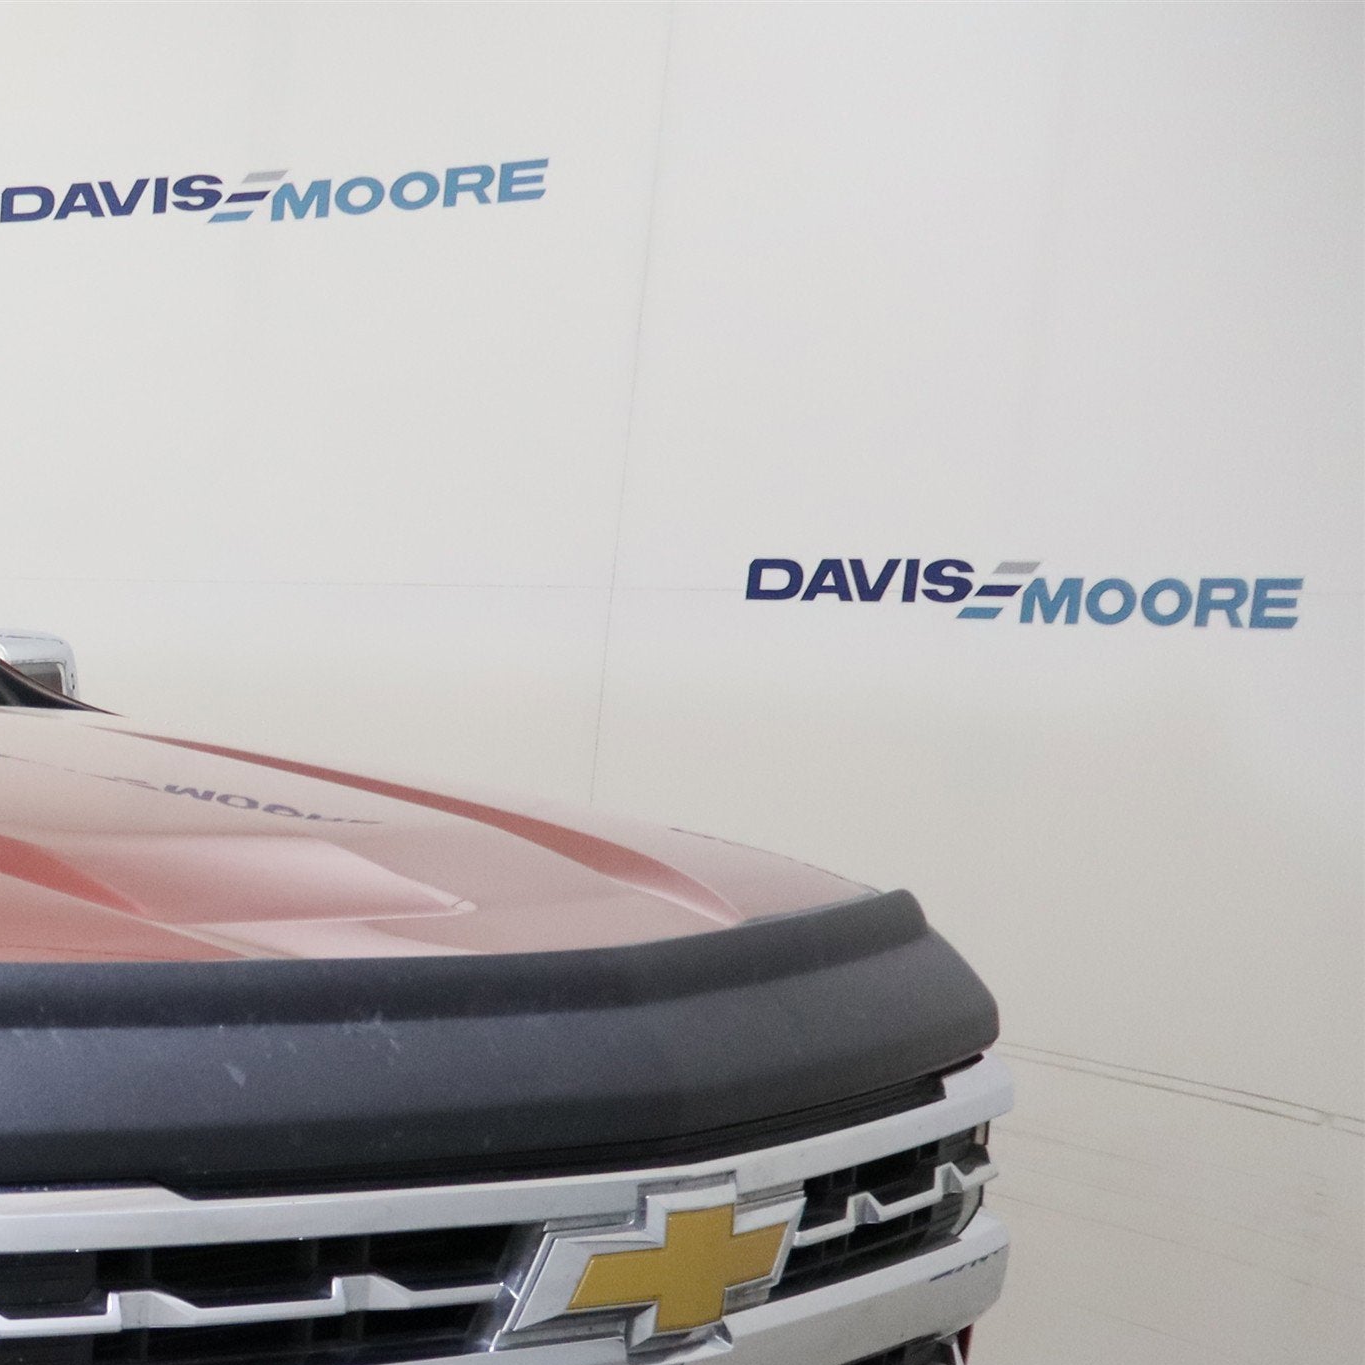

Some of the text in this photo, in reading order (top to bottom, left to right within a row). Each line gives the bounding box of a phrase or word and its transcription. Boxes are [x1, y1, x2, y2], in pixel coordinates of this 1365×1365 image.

[270, 158, 550, 222] MOORE
[744, 557, 1305, 630] DAVIS MOORE
